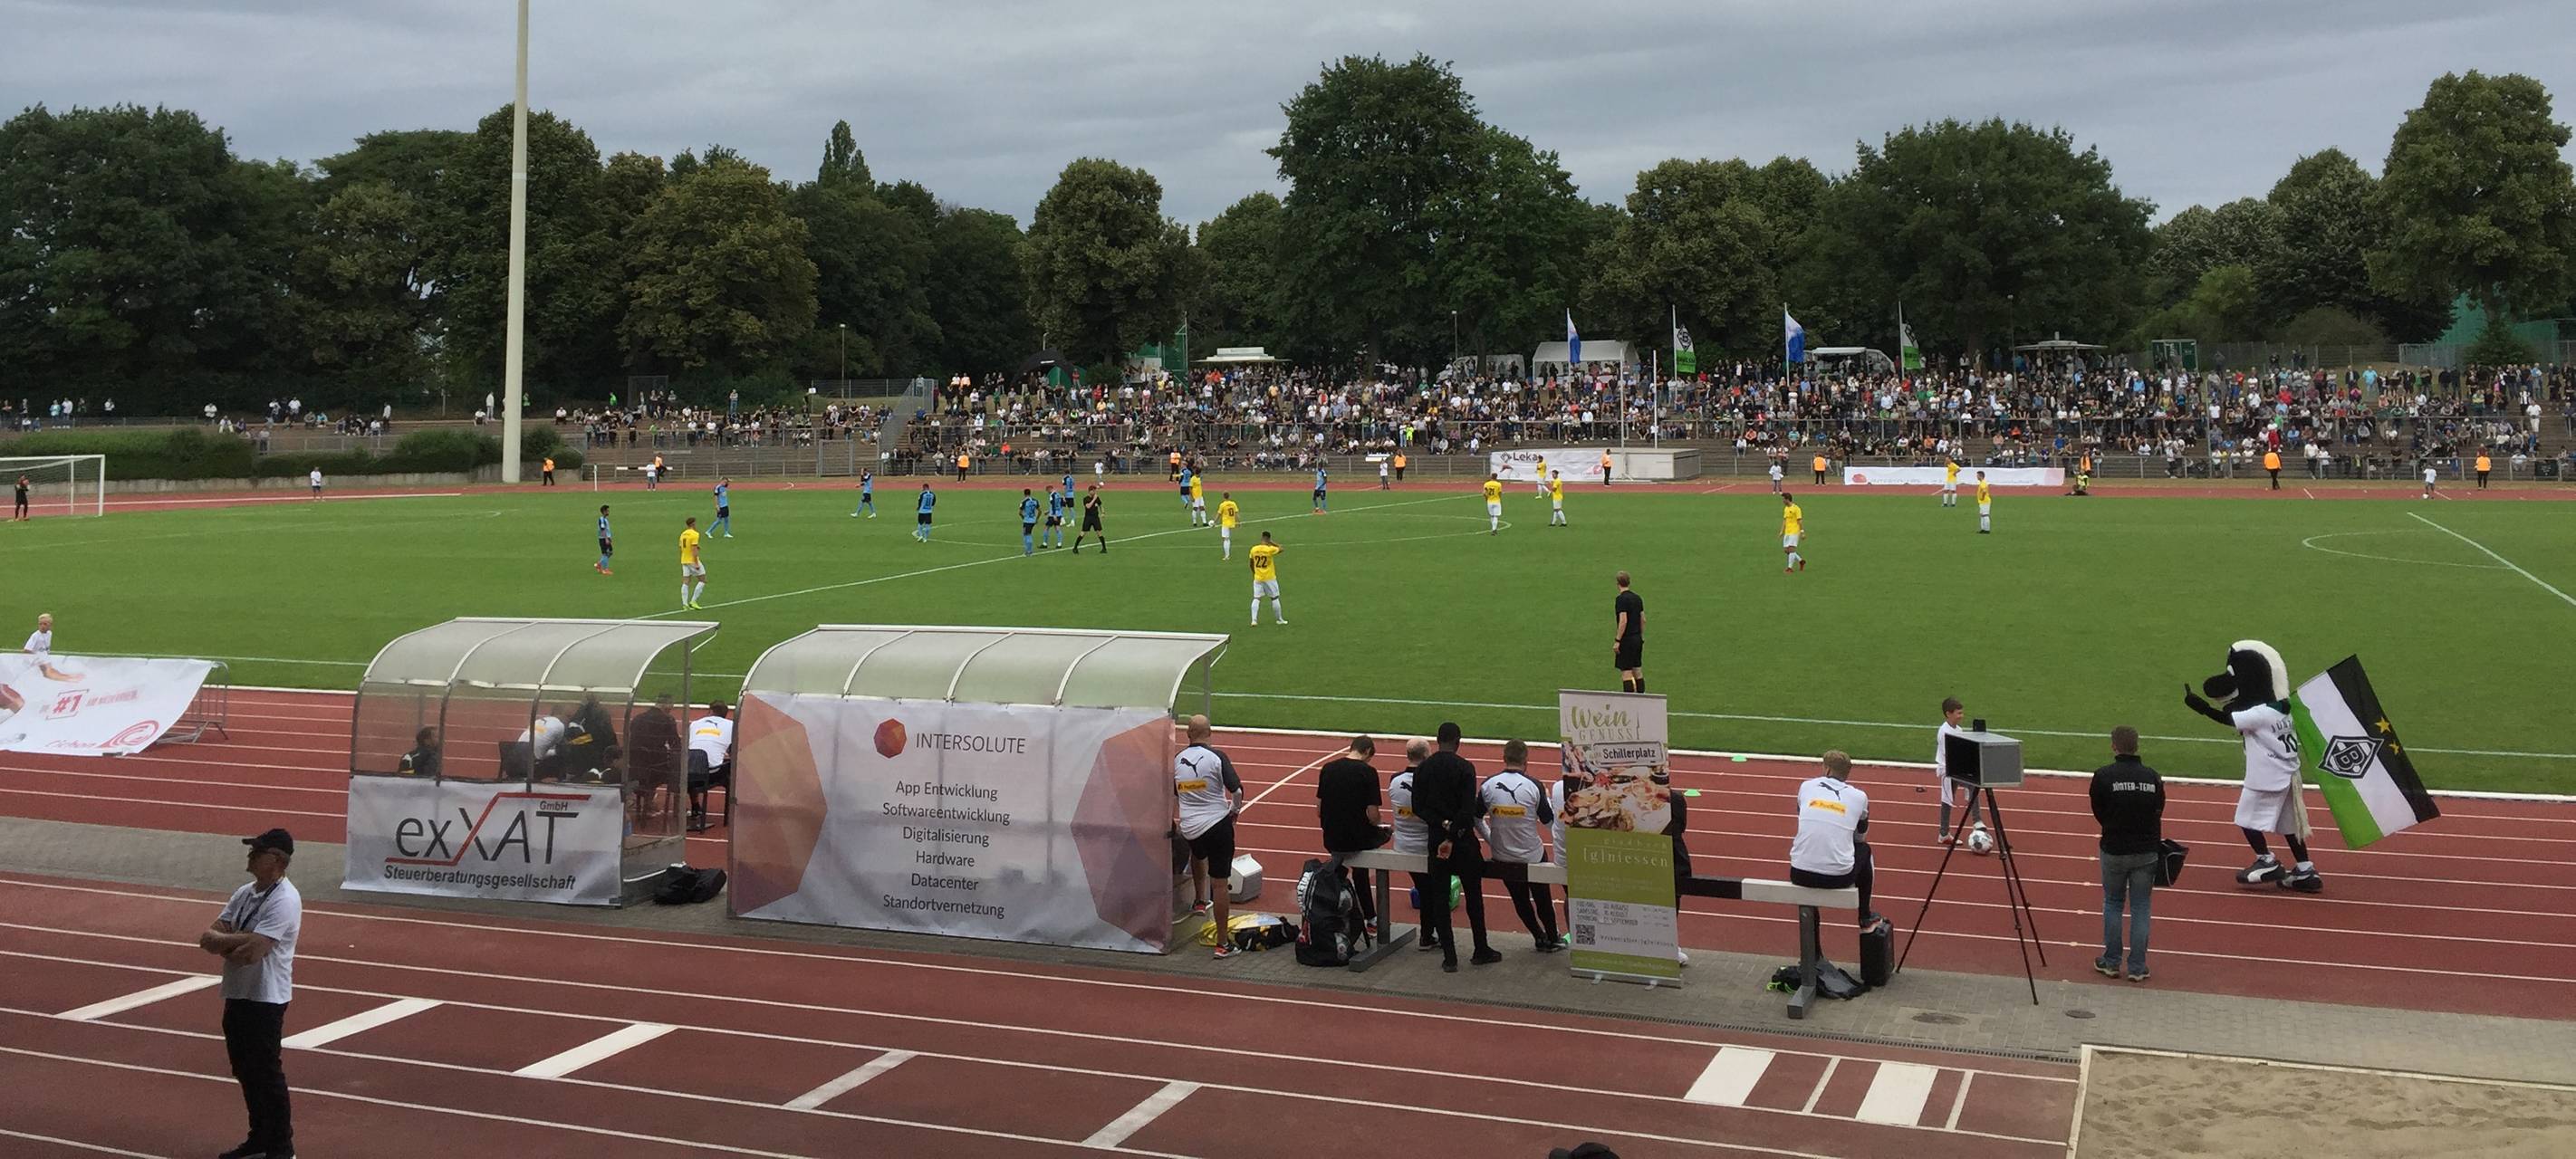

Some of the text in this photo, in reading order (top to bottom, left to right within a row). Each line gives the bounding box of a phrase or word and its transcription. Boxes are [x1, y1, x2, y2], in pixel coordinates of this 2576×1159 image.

[1254, 555, 1268, 568] 22
[1572, 704, 1630, 729] Wein
[916, 733, 1026, 753] INTERSOLUTE
[2277, 733, 2298, 752] 10
[1602, 747, 1656, 760] Schillerplatz
[896, 780, 998, 801] App Entwicklung
[539, 800, 568, 811] GmbH
[882, 802, 1011, 826] Softwareentwicklung
[903, 826, 990, 848] Digitalisierung
[916, 850, 975, 867] Hardware
[384, 865, 576, 890] Steuerberatungsgesellschaft
[911, 873, 979, 891] Datacenter
[883, 895, 1005, 919] Standortvernetzung
